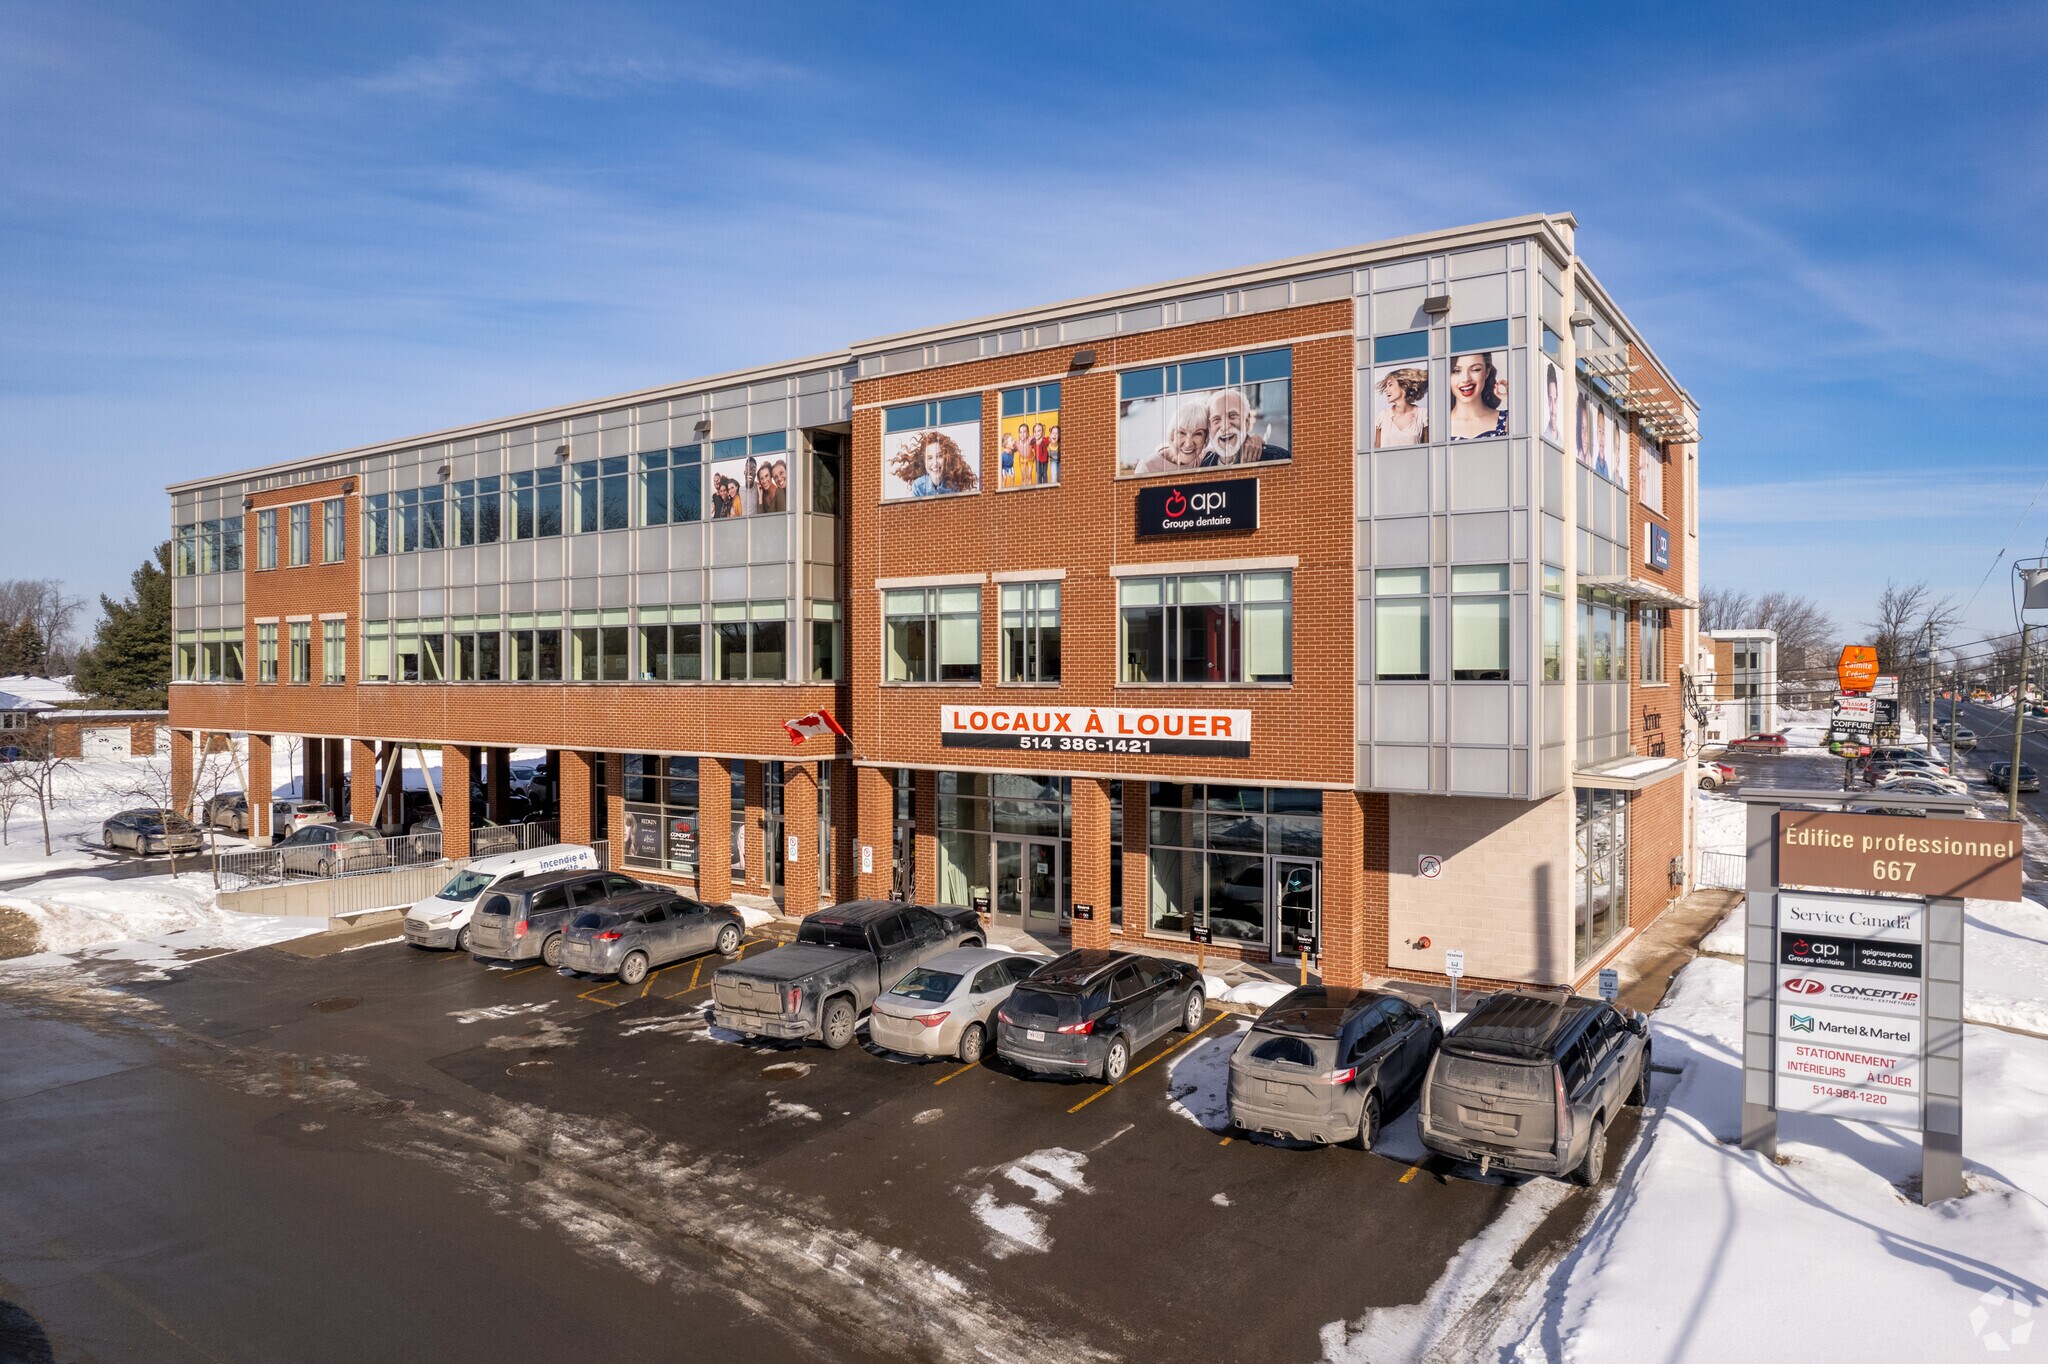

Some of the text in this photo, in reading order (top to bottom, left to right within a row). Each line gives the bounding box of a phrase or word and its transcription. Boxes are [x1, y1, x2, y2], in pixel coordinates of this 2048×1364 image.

[1191, 491, 1226, 515] api
[1162, 515, 1232, 530] Groupe dentaire
[953, 709, 1232, 737] LOCAUX À LOUER
[1832, 720, 1873, 730] COIFFURE
[1019, 736, 1151, 753] 514 386-1421
[1786, 823, 2014, 858] Édifice professionnel
[539, 851, 588, 870] Incendie et
[1873, 860, 1917, 882] 667
[1790, 906, 1911, 930] Service Canada
[1811, 943, 1913, 960] api apigroupe.com
[1788, 954, 1913, 970] Groupe dentaire 450.582.9000
[1829, 993, 1859, 1001] COIFFURE
[1819, 1021, 1911, 1042] Martel & Martel
[1796, 1046, 1897, 1069] STATIONNEMENT
[1787, 1061, 1912, 1088] INTÉRIEURS À LOUER
[1812, 1085, 1887, 1105] 514-984-1220
